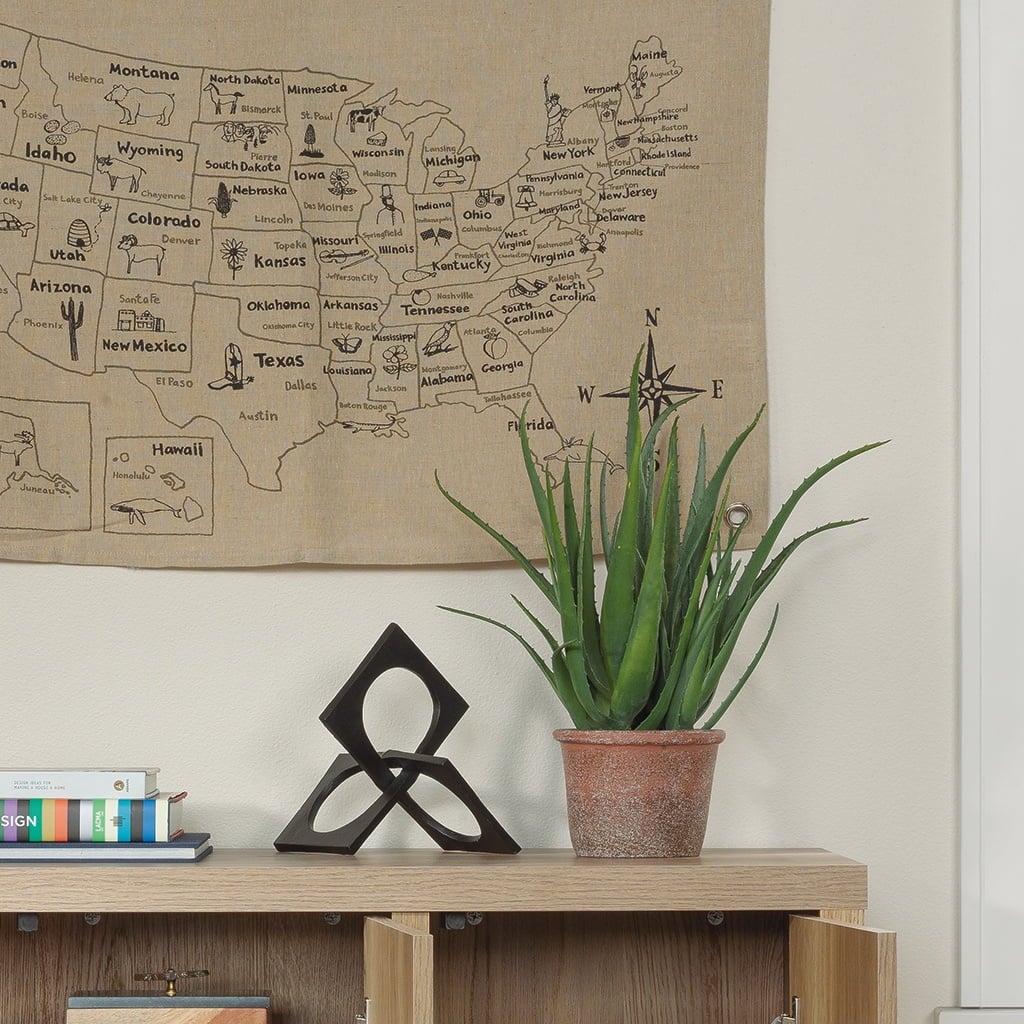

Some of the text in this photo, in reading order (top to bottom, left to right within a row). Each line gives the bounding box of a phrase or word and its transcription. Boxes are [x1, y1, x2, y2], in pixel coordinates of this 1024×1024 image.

[632, 49, 668, 61] Maine
[68, 71, 104, 84] Helena
[110, 63, 180, 81] Montana
[209, 74, 280, 86] North Dakota
[287, 83, 348, 95] Minnesota
[583, 83, 621, 95] Vermont
[22, 109, 49, 120] Boise
[241, 104, 282, 114] Bismarck
[567, 136, 600, 148] Albany
[26, 142, 77, 164] Idaho
[117, 141, 184, 162] Wyoming
[250, 152, 278, 162] Pierre
[352, 147, 404, 158] Wisconsin
[543, 146, 595, 161] New York
[667, 147, 692, 158] Island
[205, 160, 281, 172] South Dakota
[426, 153, 481, 168] Michigan
[294, 170, 325, 181] Iowa
[526, 172, 584, 185] Pennsylvania
[141, 190, 186, 201] Cheyenne
[232, 184, 287, 196] Nebraska
[599, 187, 657, 201] New Jersey
[3, 197, 23, 209] City
[415, 201, 452, 211] Indiana
[539, 202, 580, 215] Maryland
[127, 212, 201, 229] Colorado
[254, 215, 293, 225] Lincoln
[463, 210, 492, 220] Ohio
[597, 213, 645, 222] Delaware
[462, 225, 503, 233] Columbus
[505, 229, 528, 238] West
[162, 234, 200, 245] Denver
[312, 235, 358, 246] Missouri
[498, 240, 532, 250] Virginia
[274, 241, 307, 251] Topeka
[378, 244, 415, 254] Illinois
[50, 249, 86, 262] Utah
[254, 254, 306, 268] Kansas
[530, 250, 575, 266] Virginia
[432, 259, 491, 273] Kentucky
[548, 272, 580, 284] Raleigh
[30, 278, 92, 295] Arizona
[556, 281, 585, 291] North
[437, 291, 473, 300] Nashville
[550, 292, 596, 302] Carolina
[247, 299, 310, 311] Oklahoma
[323, 300, 378, 312] Arkansas
[401, 304, 470, 316] Tennessee
[502, 301, 532, 314] South
[504, 310, 554, 325] Carolina
[645, 307, 660, 327] N
[23, 318, 64, 330] Phoenix
[327, 321, 377, 332] Little Rock
[372, 332, 416, 343] Mississippi
[103, 339, 188, 353] New Mexico
[254, 353, 304, 368] Texas
[323, 365, 372, 376] Louisiana
[482, 360, 523, 374] Georgia
[156, 377, 193, 388] El Paso
[285, 381, 318, 391] Dallas
[421, 373, 473, 388] Alabama
[375, 384, 407, 393] Jackson
[711, 380, 724, 399] E
[578, 386, 596, 404] W
[239, 410, 278, 421] Austin
[508, 420, 554, 431] Flrida
[153, 443, 203, 457] Hawaii
[113, 471, 150, 480] Honolulu
[20, 483, 55, 496] Juneau
